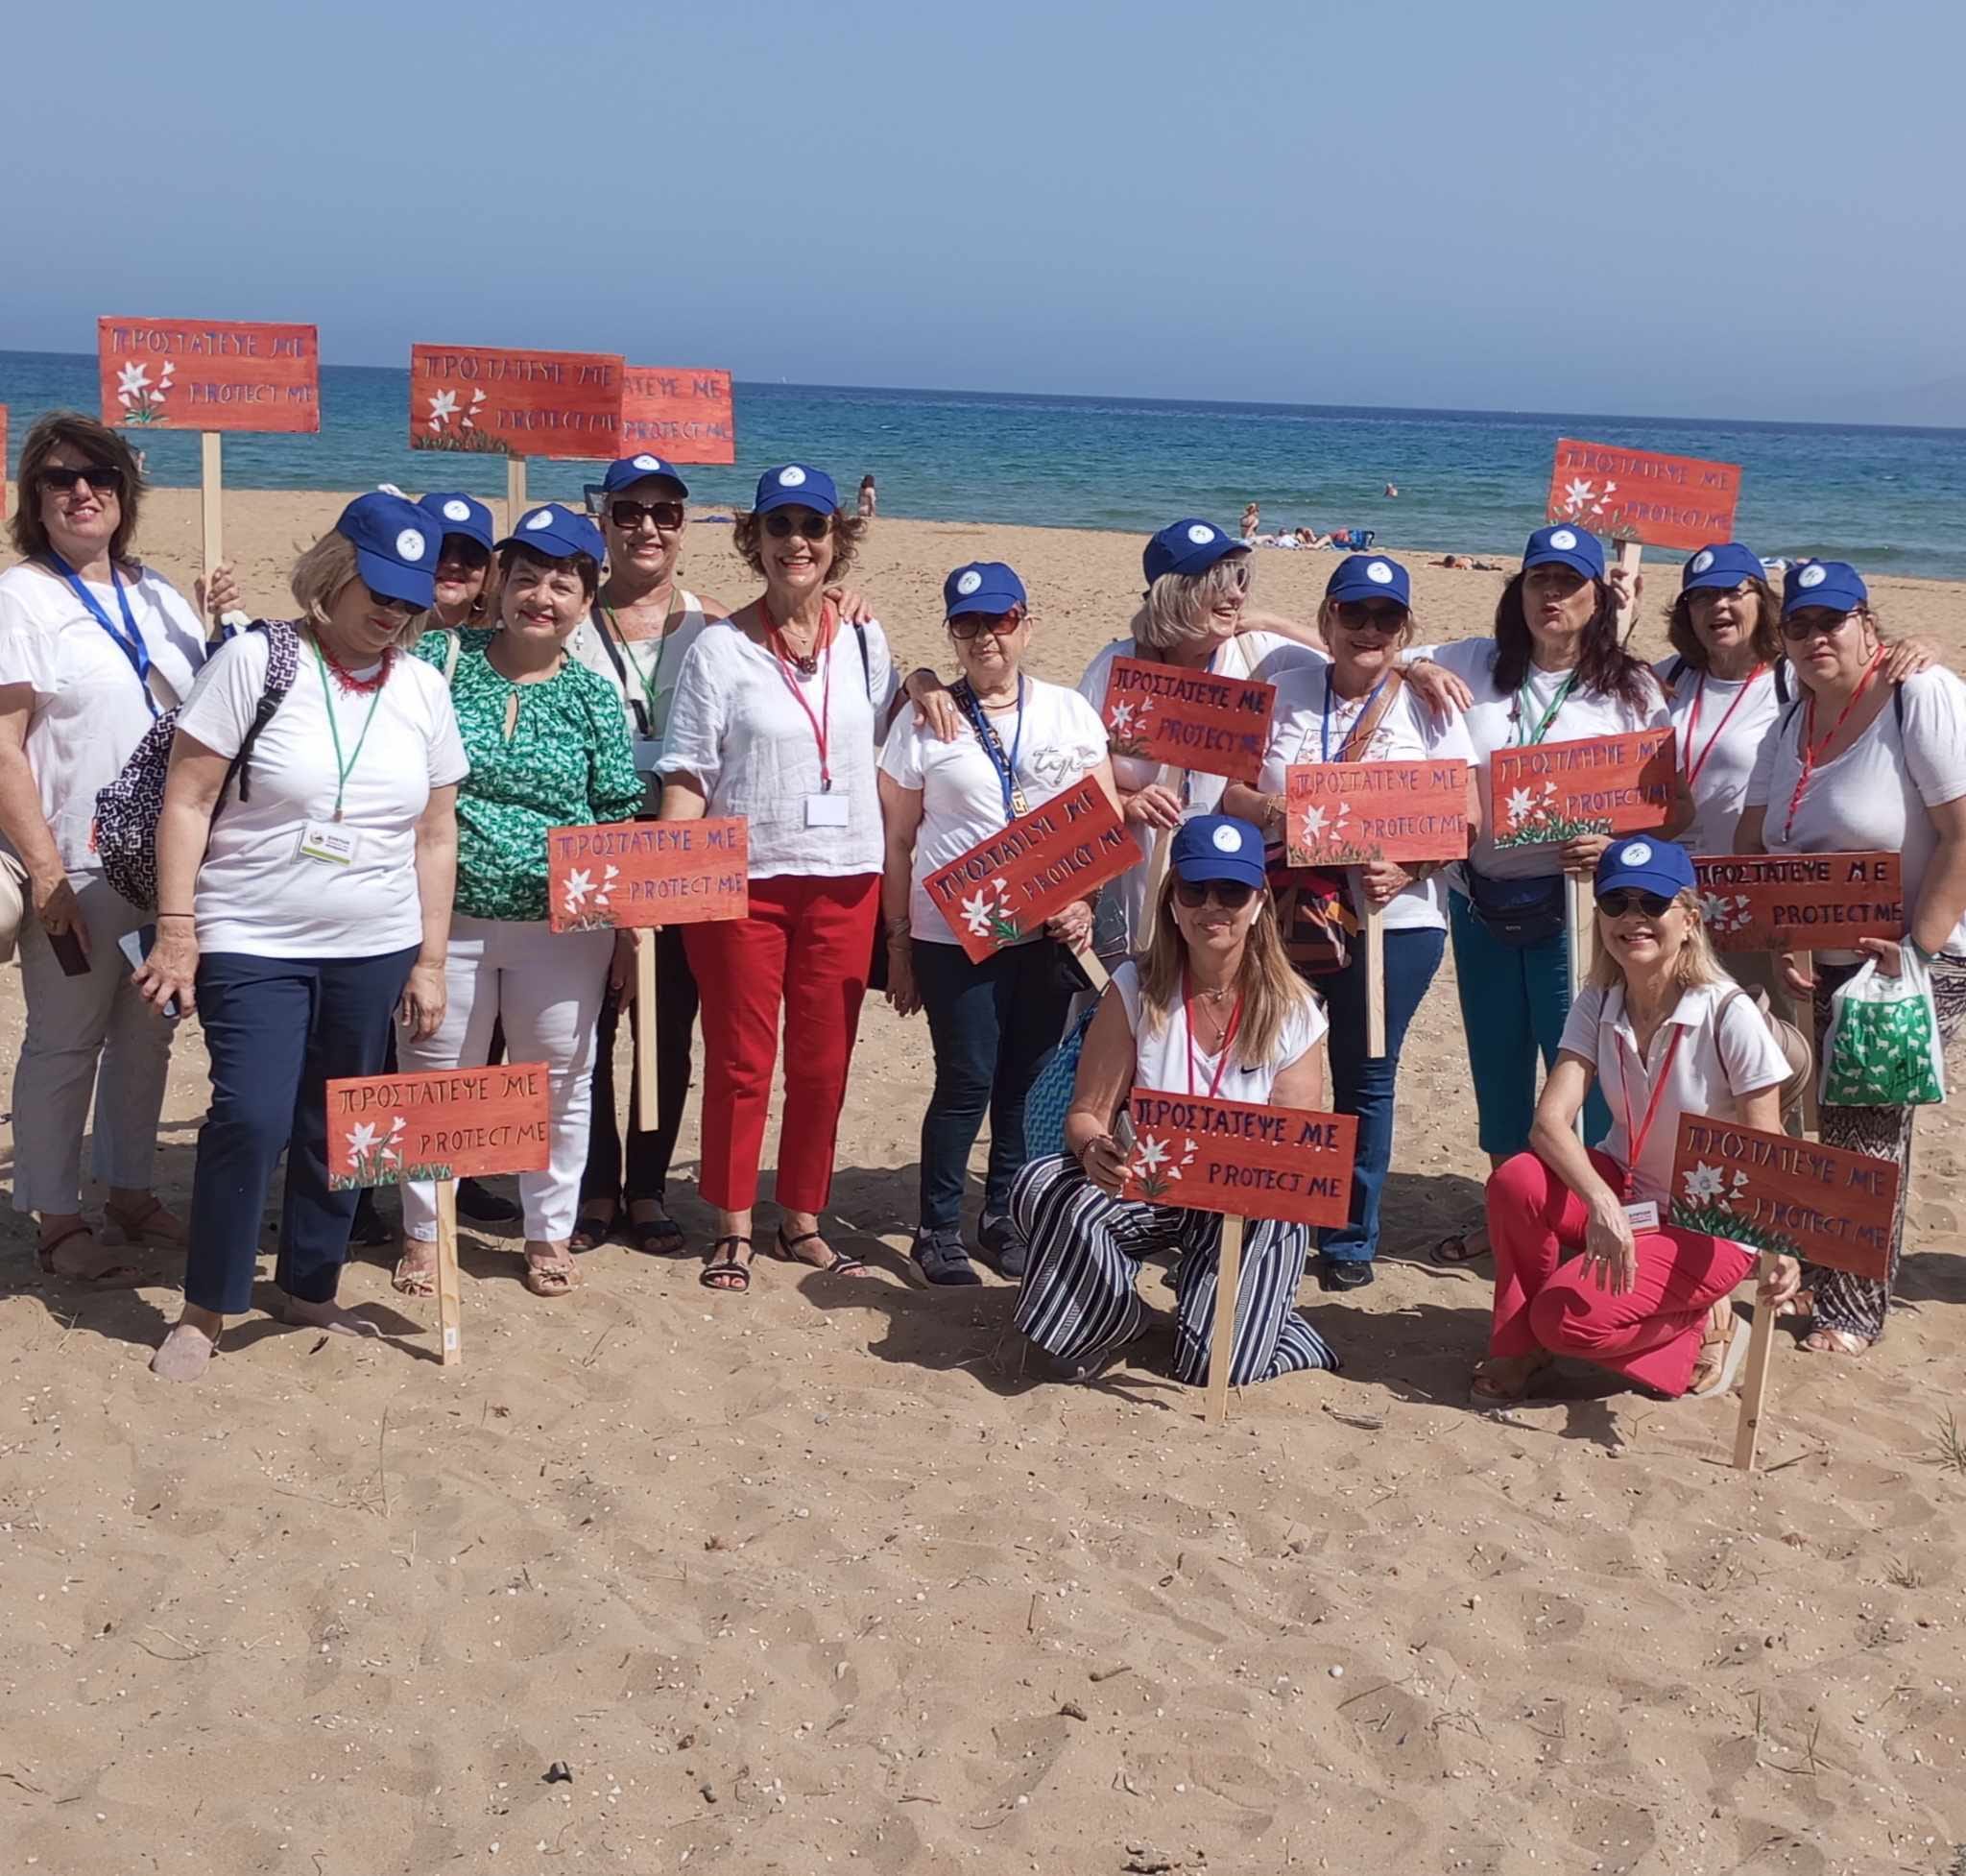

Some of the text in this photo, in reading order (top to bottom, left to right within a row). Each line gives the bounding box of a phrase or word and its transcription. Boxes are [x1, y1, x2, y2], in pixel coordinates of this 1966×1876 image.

[1238, 690, 1268, 714] ΜΕ
[1428, 768, 1463, 791] ΜΕ
[706, 827, 738, 850] ΜΕ
[1360, 813, 1466, 840] PROTECT ME
[1846, 860, 1888, 883] ΜΕ
[629, 873, 744, 902] PROTECT ME
[1773, 902, 1905, 926] PROTECT ME
[500, 1072, 539, 1097] ΜΕ
[419, 1120, 546, 1155] PROTECT ME
[1294, 1121, 1339, 1151] ΜΕ
[1208, 1162, 1342, 1197] PROTECT ME
